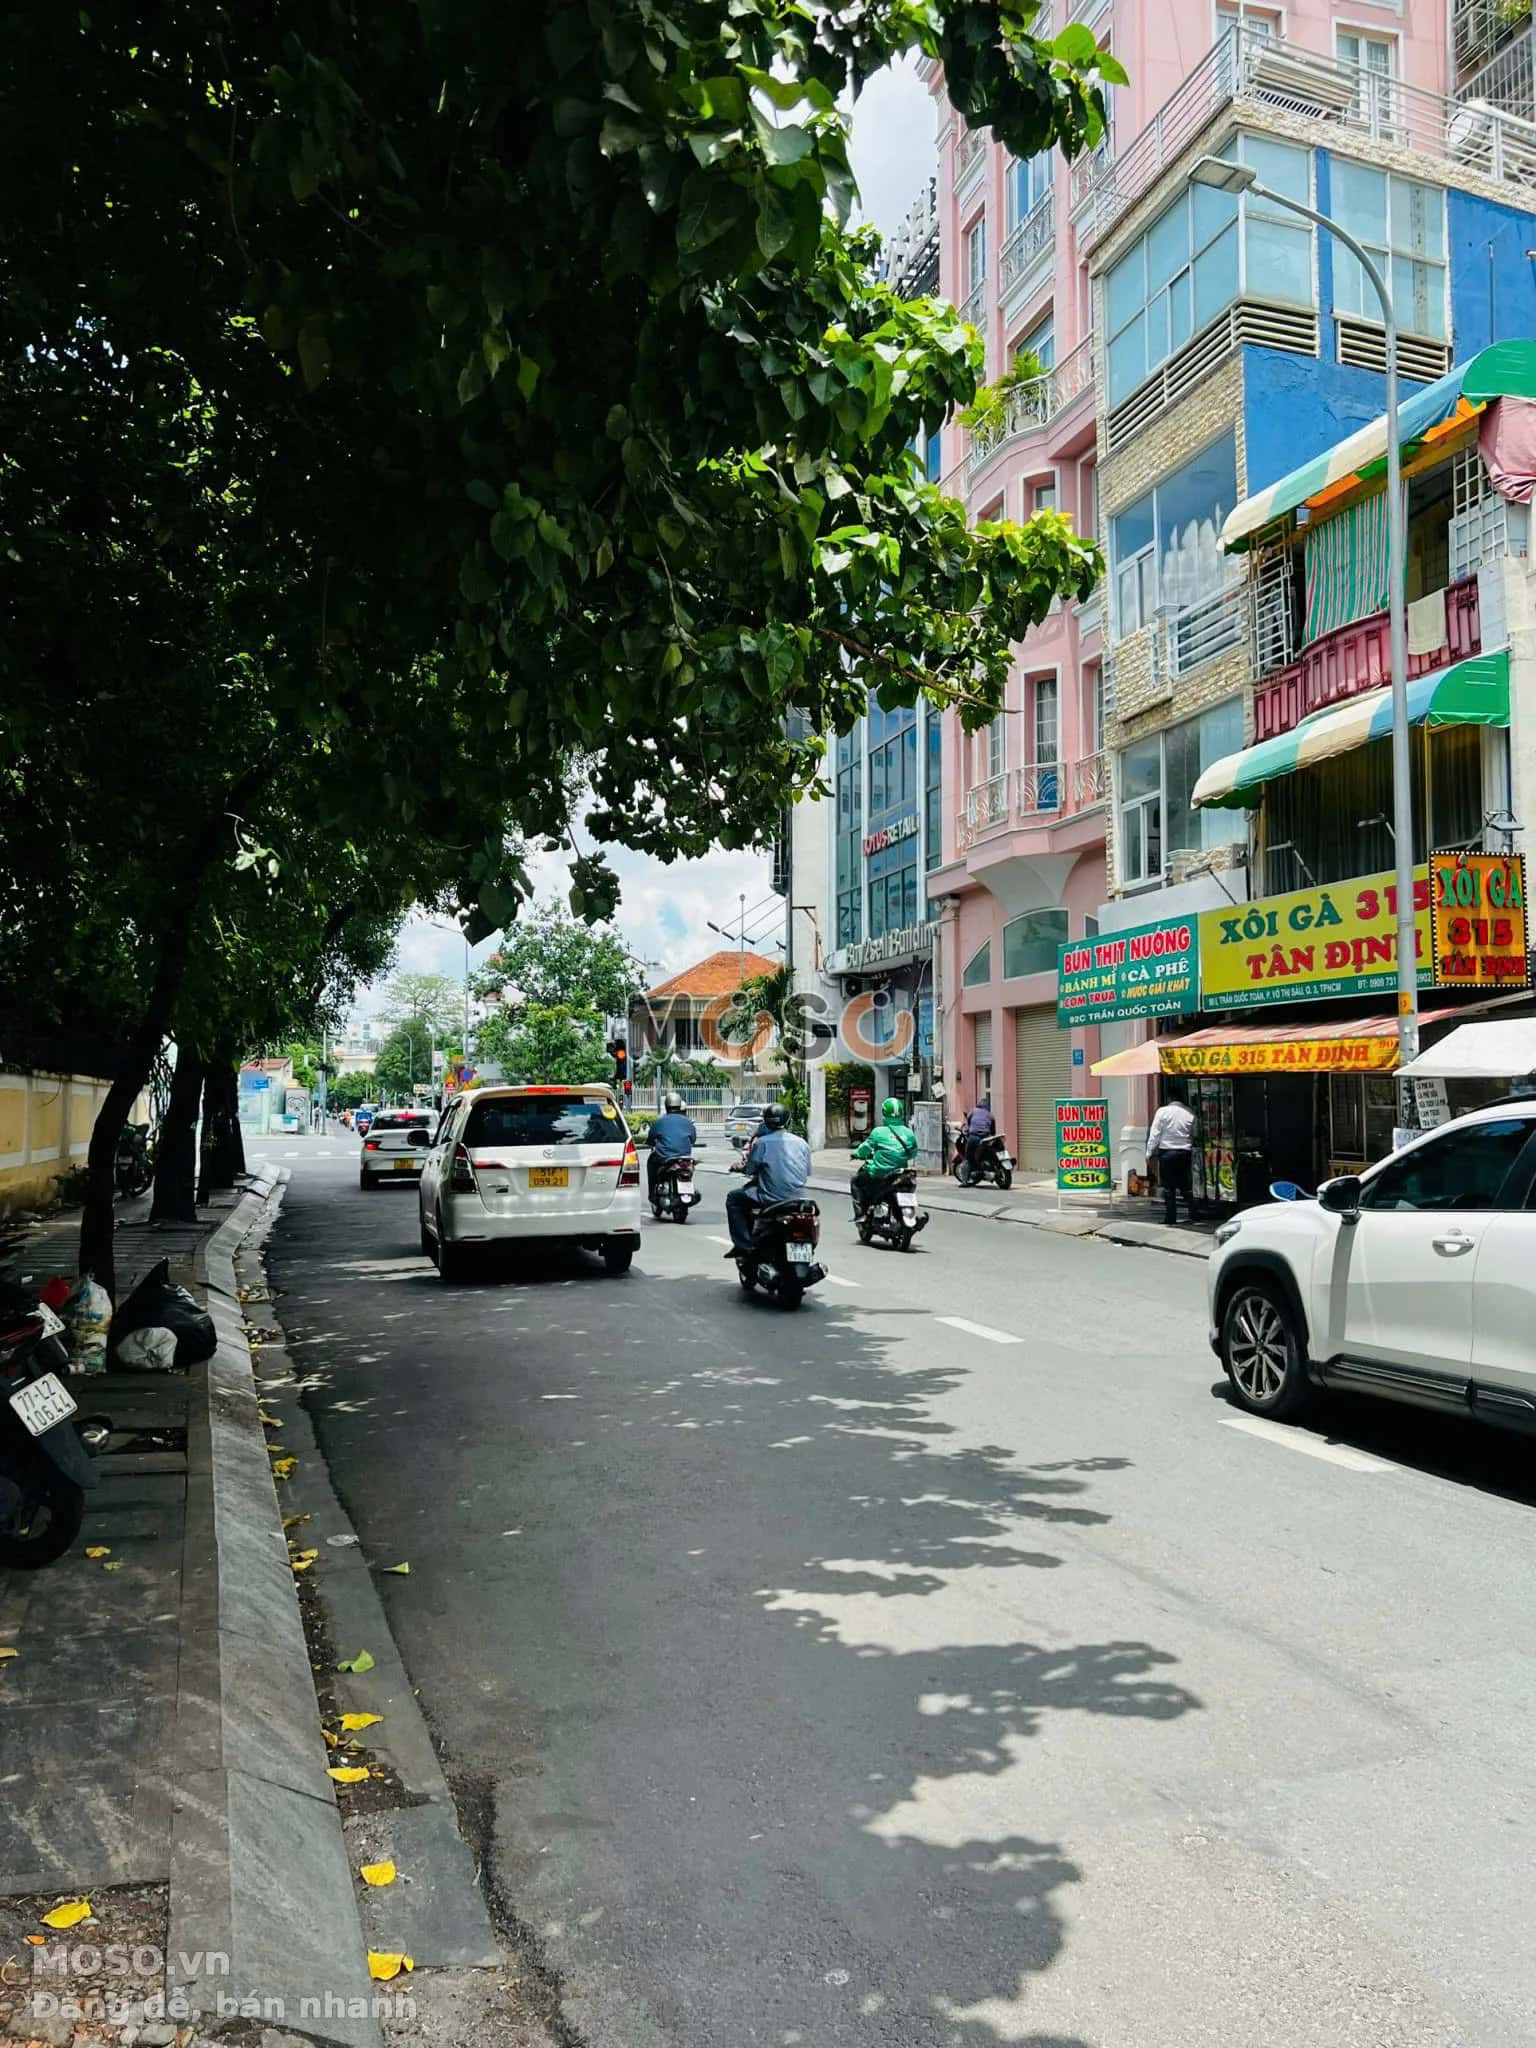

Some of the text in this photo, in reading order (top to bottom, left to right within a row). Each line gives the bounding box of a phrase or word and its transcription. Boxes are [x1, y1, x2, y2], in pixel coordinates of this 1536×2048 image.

[1438, 854, 1524, 908] XÔI GÀ
[1219, 908, 1278, 945] XÔI
[1288, 892, 1343, 931] GÀ
[1449, 917, 1513, 945] 315
[1064, 945, 1092, 975] BÚN
[1095, 940, 1127, 969] THỊT
[1127, 957, 1190, 982] CÀ PHÊ
[1246, 944, 1316, 980] TÂN
[1441, 950, 1476, 976] TÂN
[1064, 977, 1099, 993] BÁNH
[1117, 1002, 1148, 1017] QUỐC
[1238, 1050, 1266, 1066] 315
[1271, 1044, 1313, 1064] TÂN
[1057, 1103, 1080, 1122] BÚN
[17, 1380, 56, 1413] 77-L2
